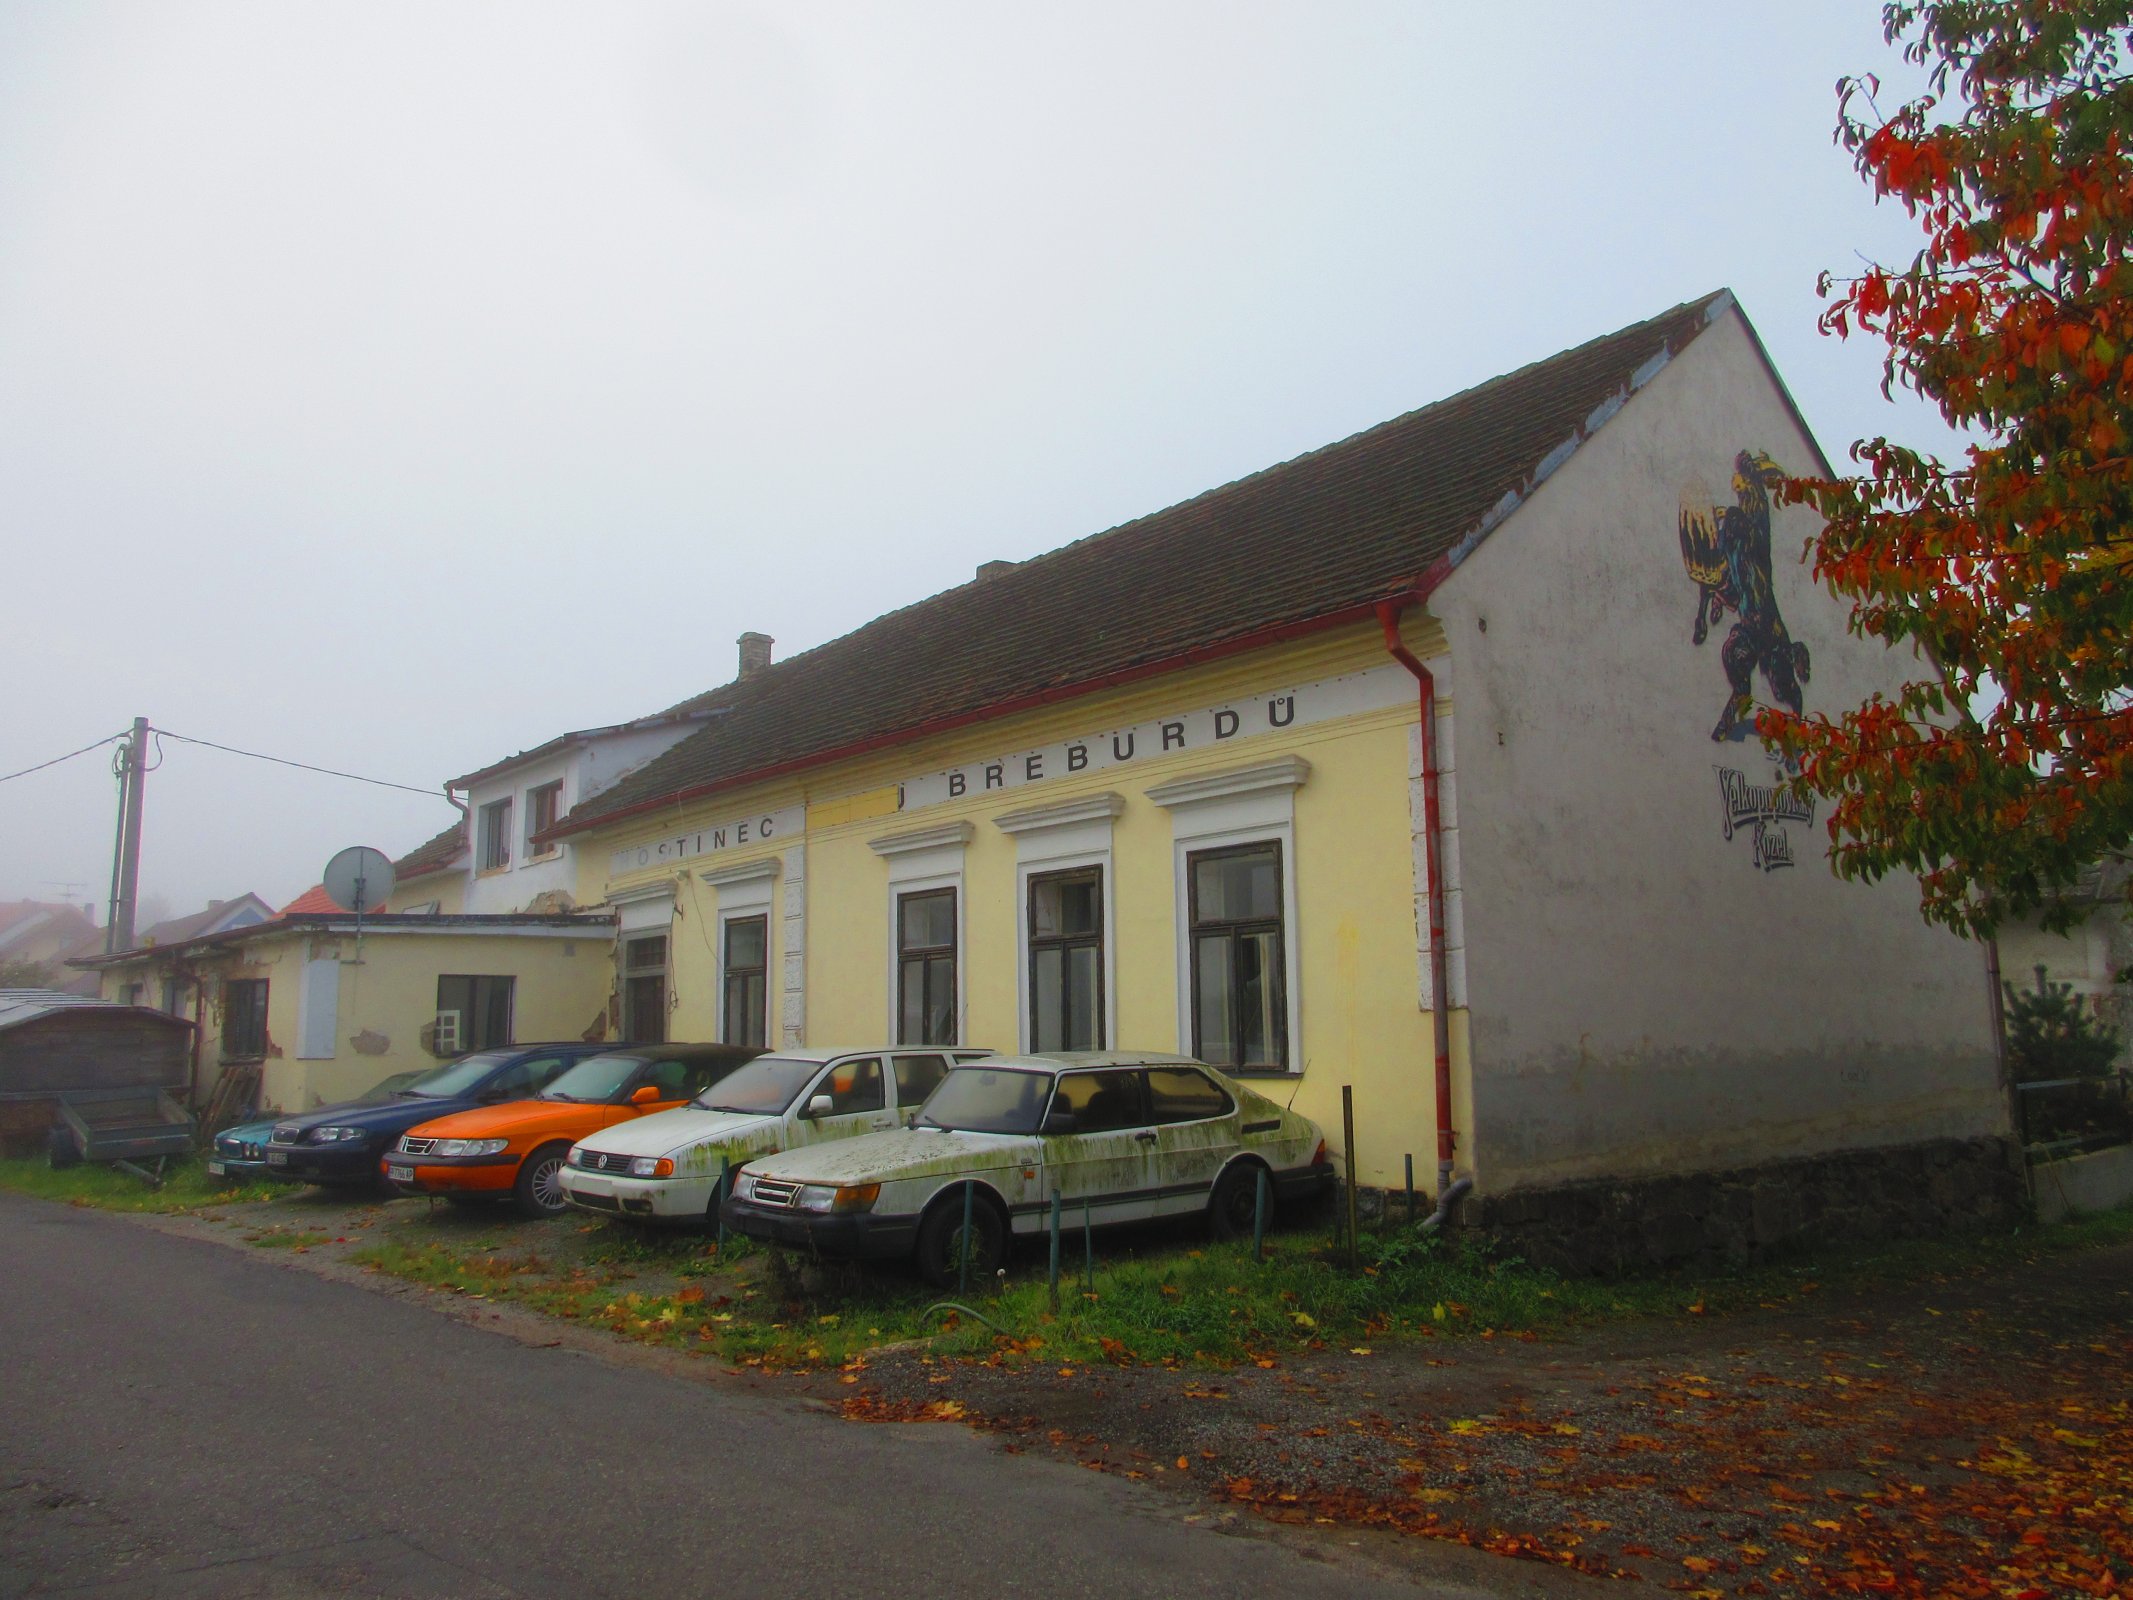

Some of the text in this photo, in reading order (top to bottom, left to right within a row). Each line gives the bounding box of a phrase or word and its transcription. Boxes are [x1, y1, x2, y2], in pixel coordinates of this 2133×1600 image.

[614, 818, 773, 868] OSTINEC
[949, 696, 1295, 798] BREBURDŮ
[1752, 822, 1793, 872] Kozel
